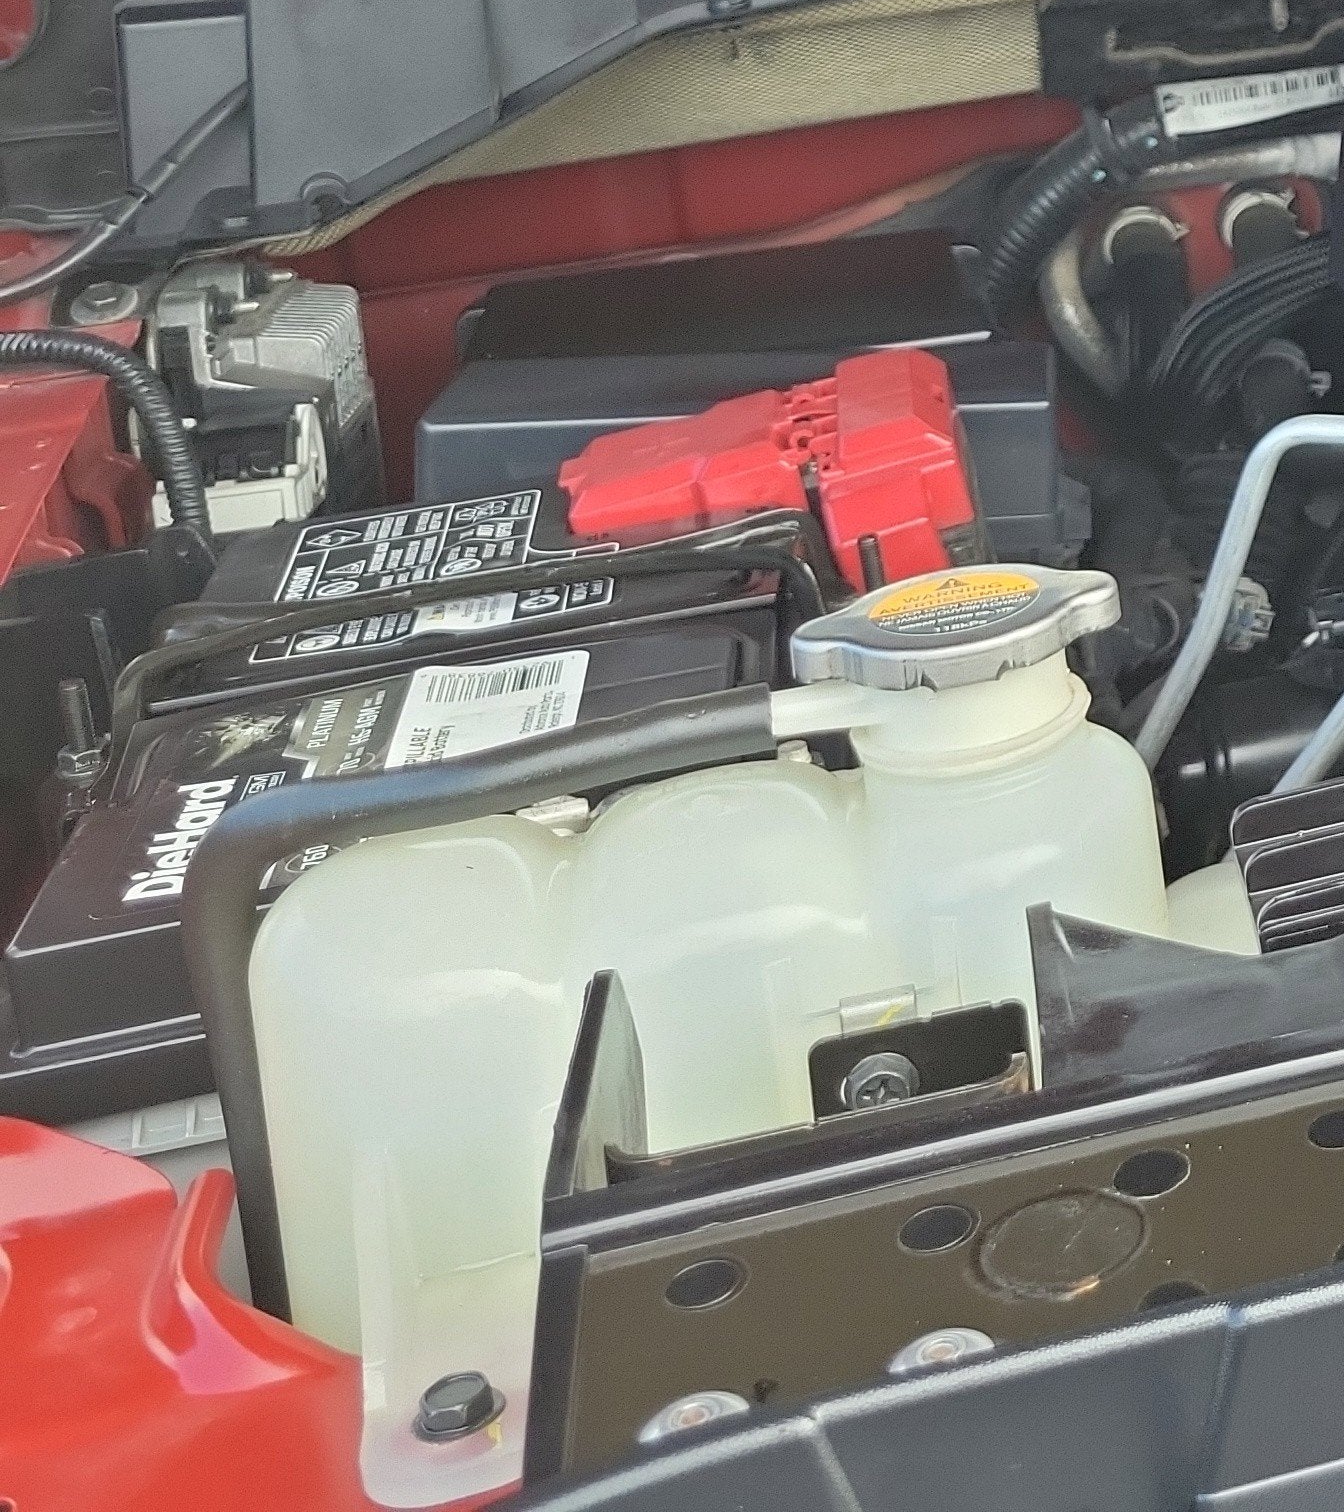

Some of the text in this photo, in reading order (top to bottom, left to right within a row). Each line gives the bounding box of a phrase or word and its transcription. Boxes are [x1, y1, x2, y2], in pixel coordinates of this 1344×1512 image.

[880, 583, 1029, 615] AVERTISSEMENT
[903, 581, 1003, 604] WARNING
[306, 699, 344, 749] PLATINUM
[404, 726, 432, 765] PILLABLE
[248, 774, 266, 795] GM
[121, 776, 237, 902] DieHard
[300, 843, 330, 870] 760
